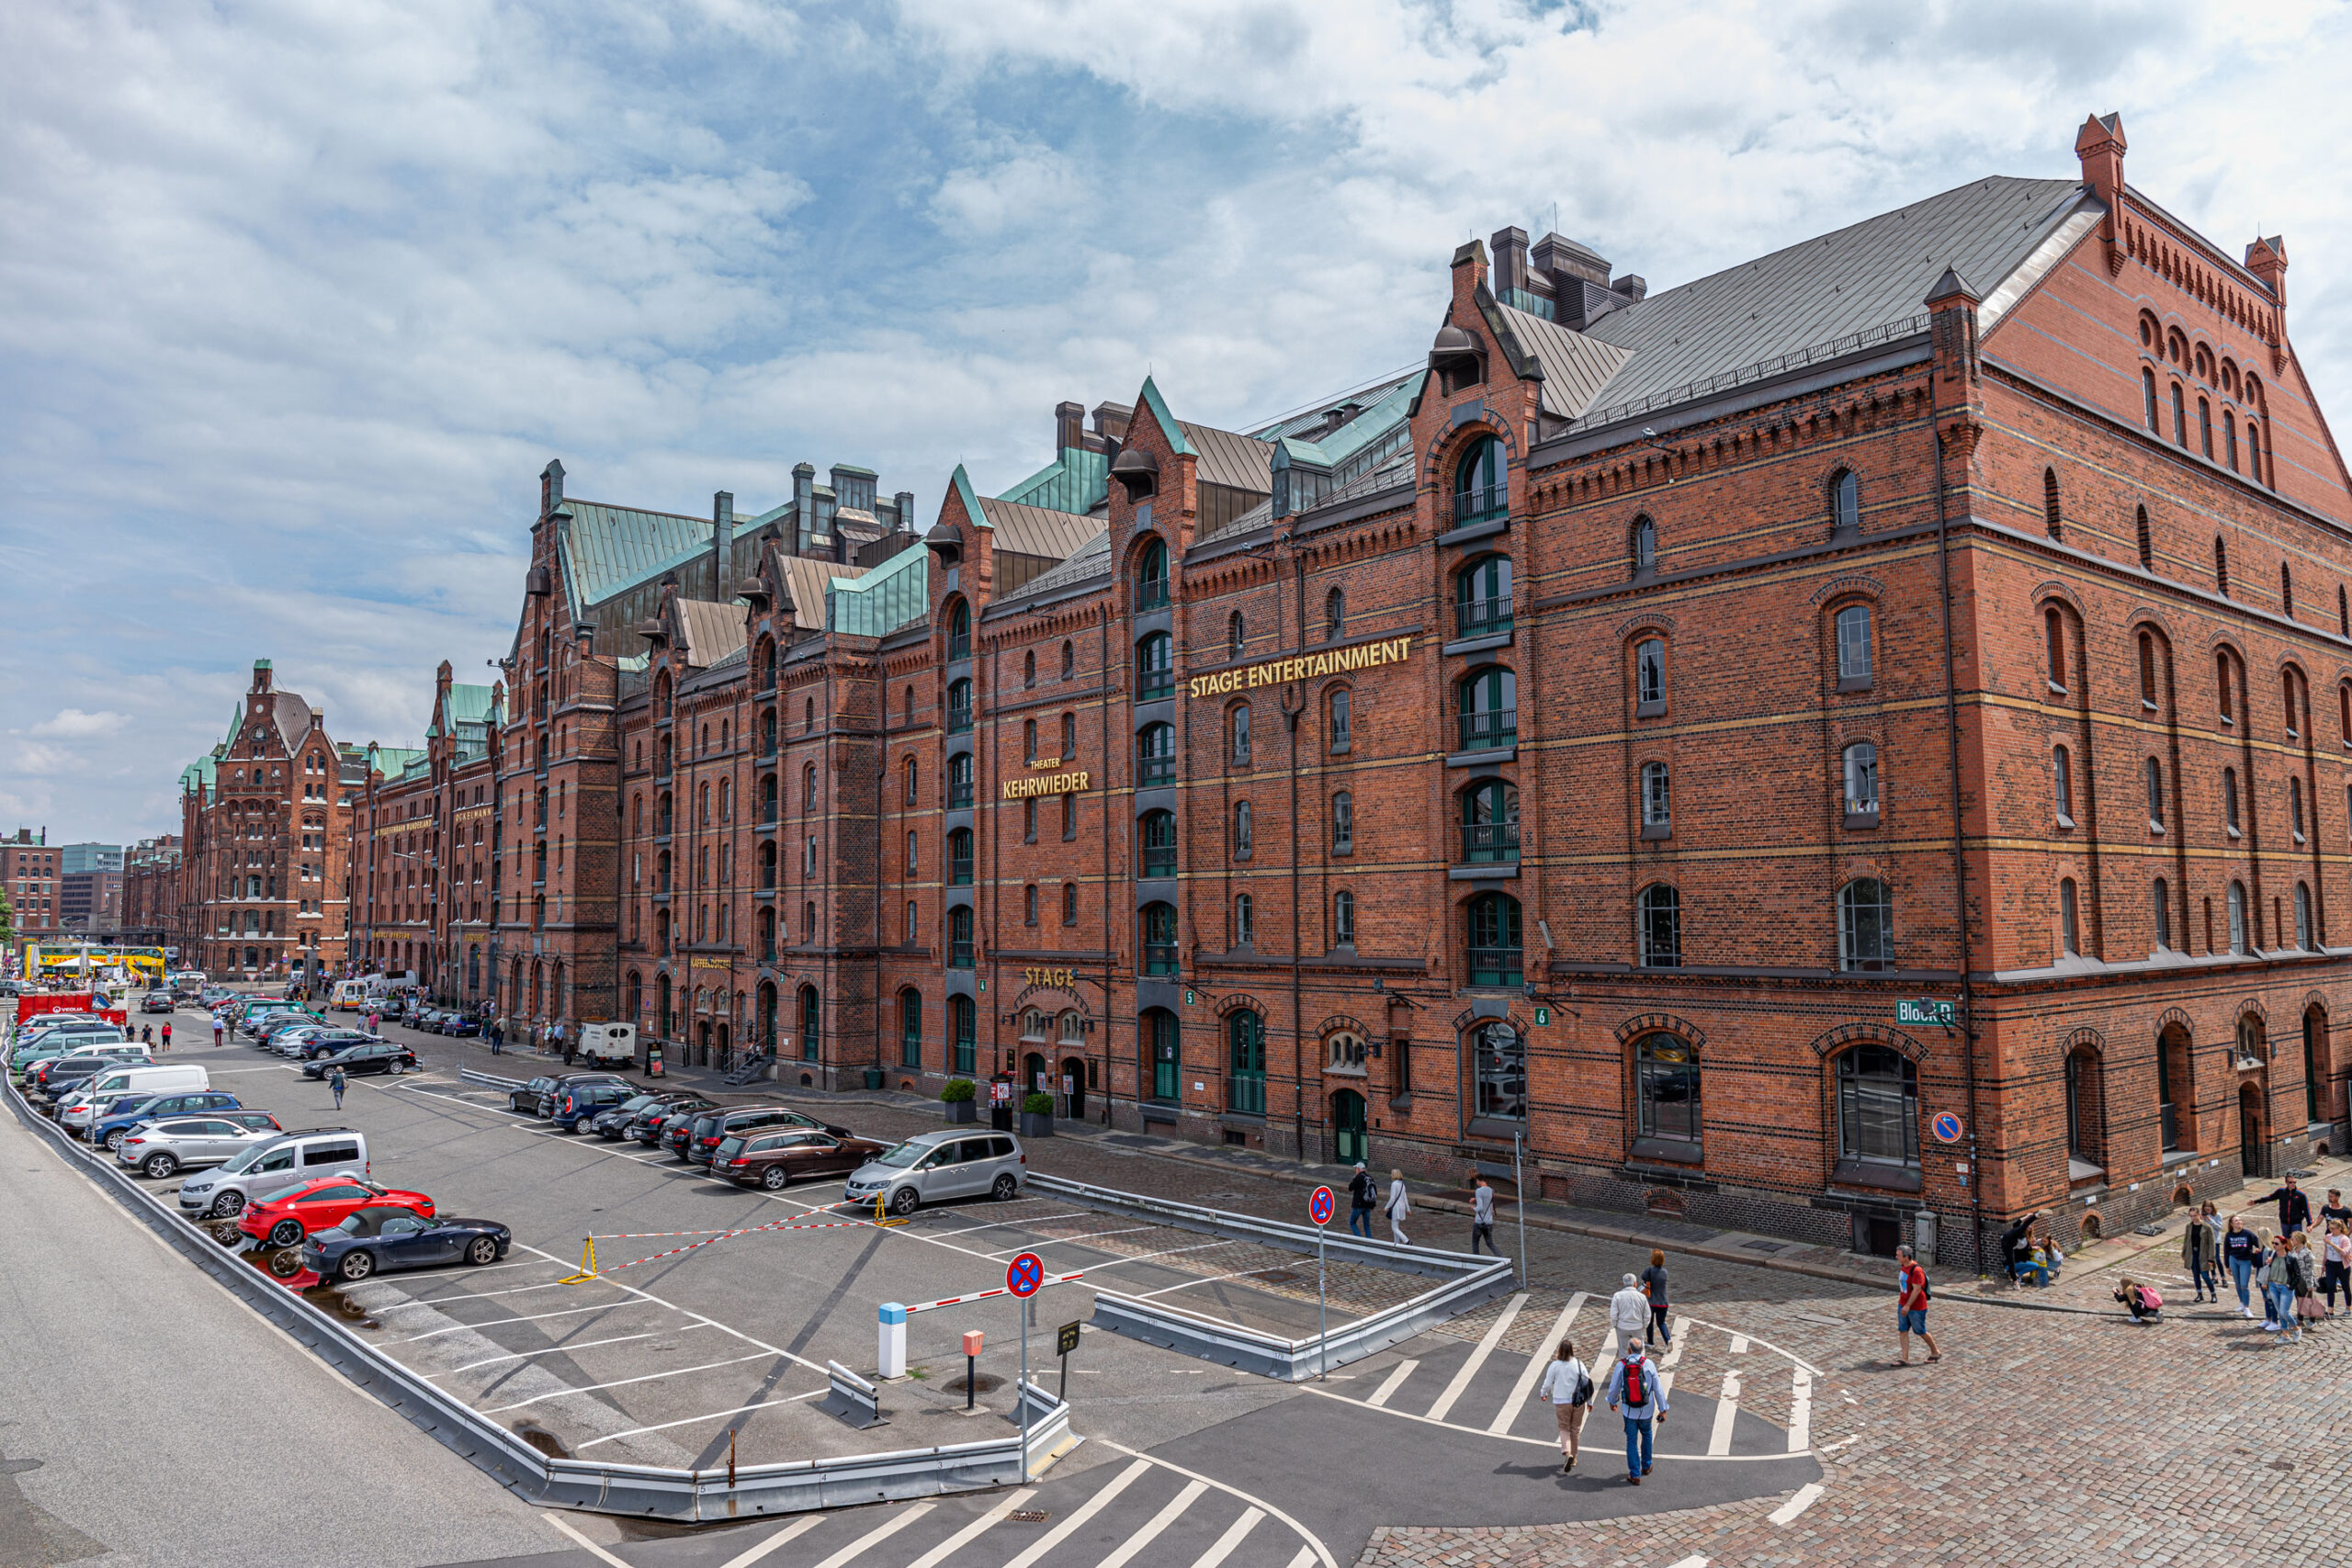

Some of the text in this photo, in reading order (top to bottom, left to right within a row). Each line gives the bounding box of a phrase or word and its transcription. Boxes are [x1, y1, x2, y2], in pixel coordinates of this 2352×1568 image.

[1190, 637, 1412, 699] STAGE ENTERTAINMENT
[1030, 757, 1061, 771] THEATER
[1003, 771, 1090, 800] KEHRWIEDER
[1024, 966, 1076, 987] STAGE
[1187, 993, 1193, 1003] 5
[1539, 1010, 1545, 1024] 6
